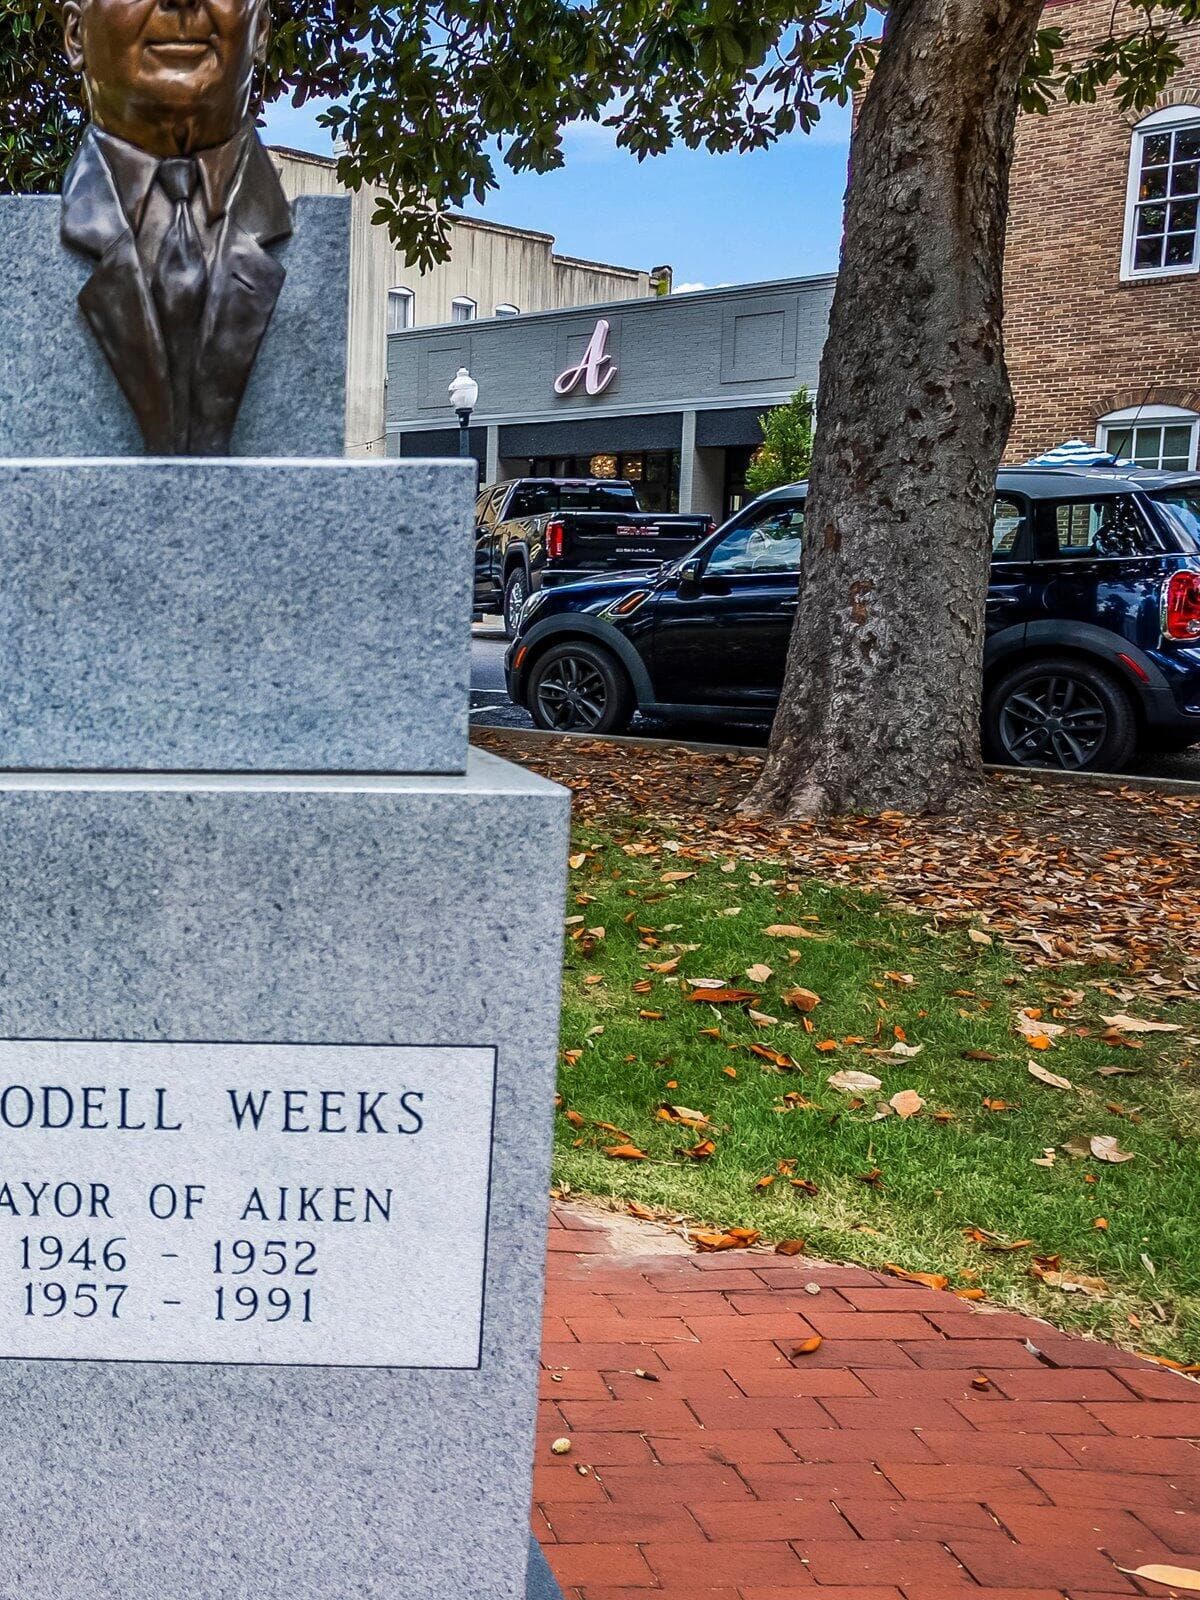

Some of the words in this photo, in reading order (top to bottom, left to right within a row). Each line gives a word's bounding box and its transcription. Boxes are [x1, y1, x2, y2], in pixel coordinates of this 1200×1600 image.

[0, 1085, 182, 1130] ODELL
[227, 1089, 424, 1134] WEEKS
[149, 1183, 205, 1220] OF
[240, 1187, 394, 1223] AIKEN
[20, 1236, 127, 1273] 1946
[213, 1240, 319, 1276] 1952
[24, 1282, 128, 1319] 1957
[214, 1286, 314, 1323] 1991
